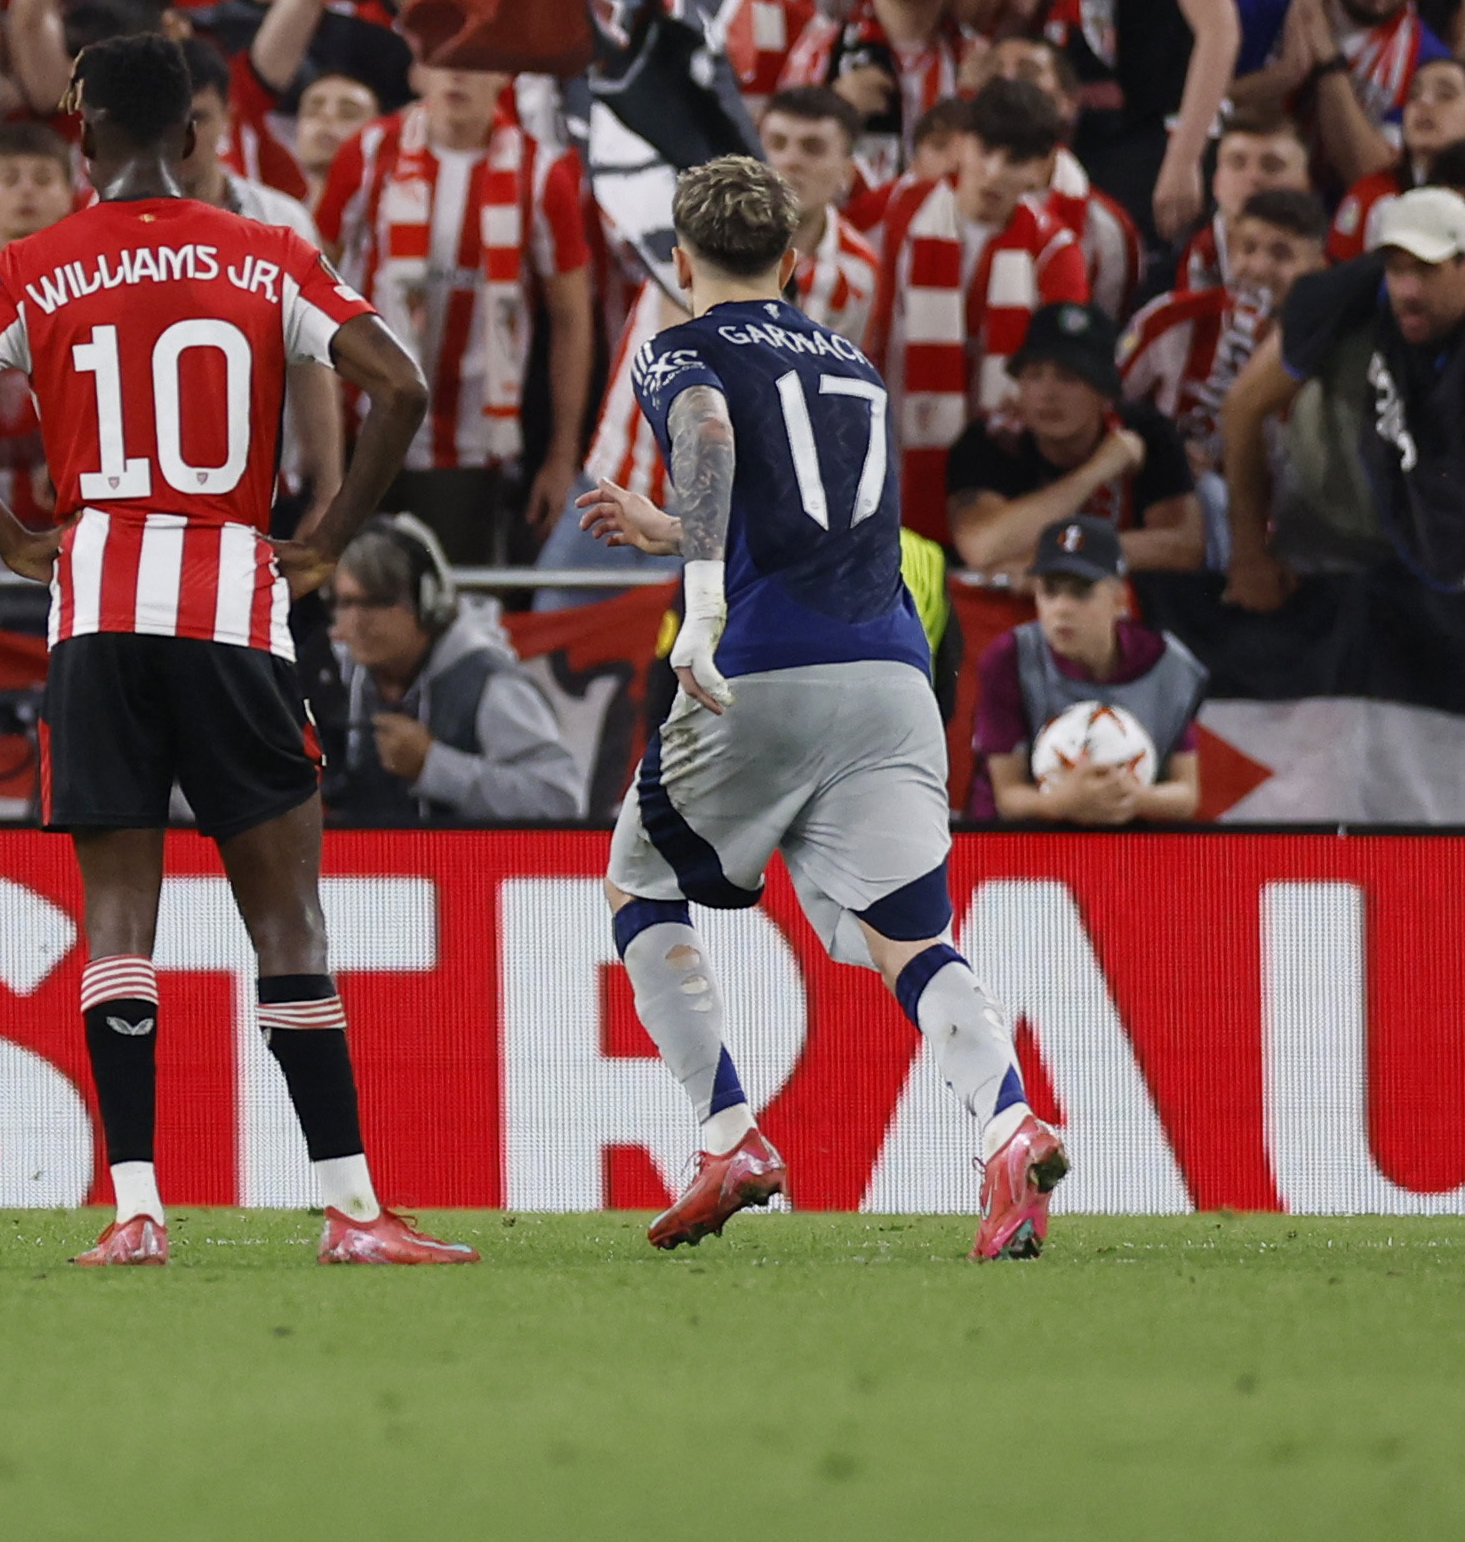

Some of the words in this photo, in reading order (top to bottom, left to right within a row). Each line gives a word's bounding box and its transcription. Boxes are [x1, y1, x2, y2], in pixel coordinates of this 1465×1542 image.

[25, 244, 219, 315] WILLIAMS
[227, 255, 279, 304] JR.
[72, 319, 251, 499] 10
[775, 369, 888, 531] 17
